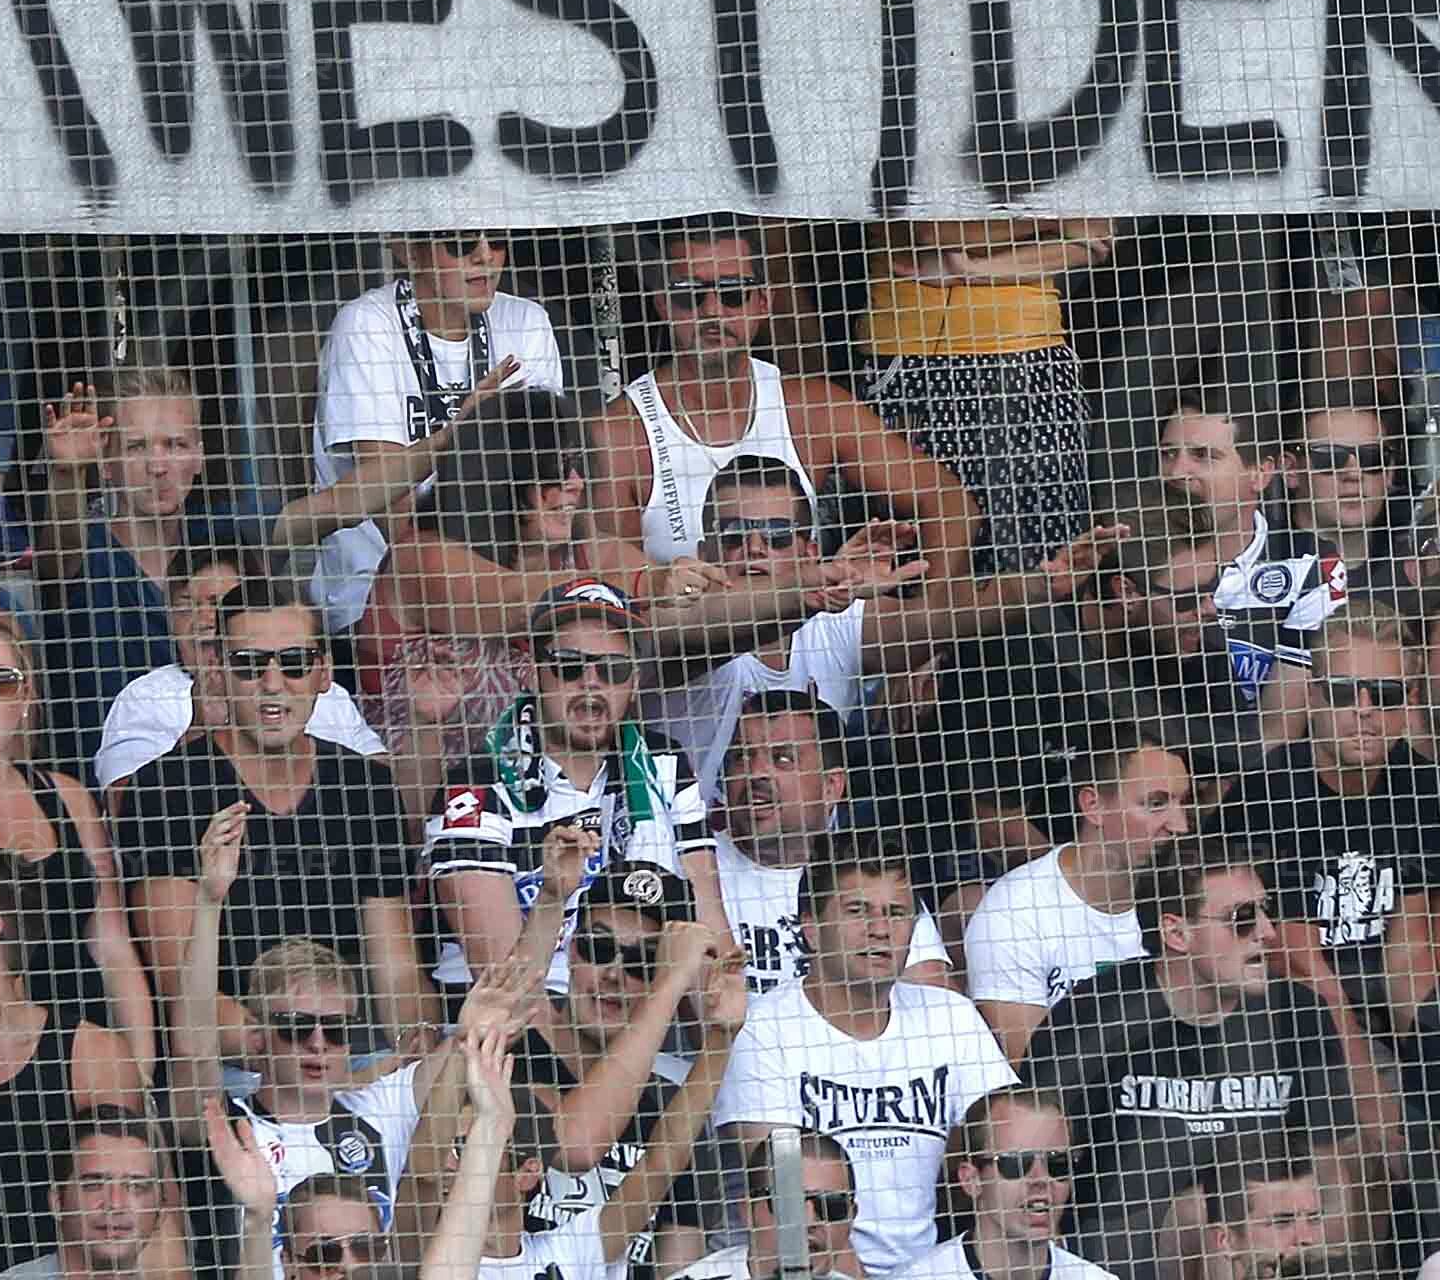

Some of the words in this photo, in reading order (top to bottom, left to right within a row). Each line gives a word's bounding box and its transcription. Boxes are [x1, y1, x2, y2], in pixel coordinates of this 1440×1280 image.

[660, 465, 688, 543] DIFFERENT
[800, 1065, 951, 1130] STURM
[1120, 1074, 1216, 1113] STURM
